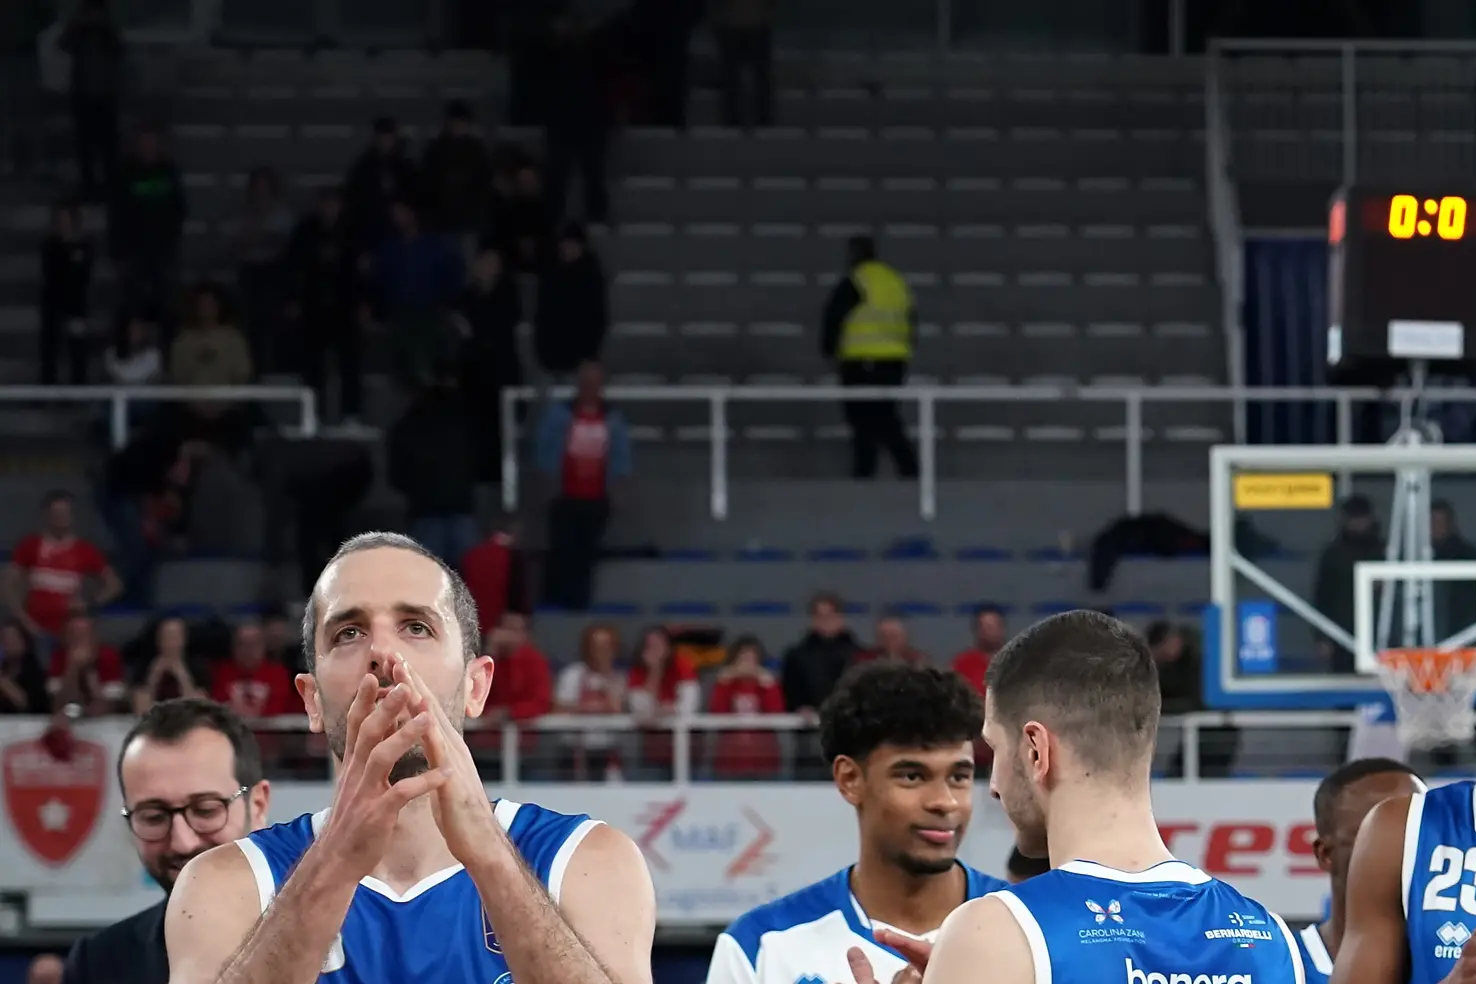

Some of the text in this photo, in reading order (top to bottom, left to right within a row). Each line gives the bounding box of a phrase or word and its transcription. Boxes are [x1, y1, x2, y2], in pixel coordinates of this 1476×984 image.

[1388, 194, 1467, 240] 0:0
[1078, 928, 1125, 939] CAROLINA
[1204, 928, 1272, 941] BERNARDELLI
[1434, 945, 1462, 959] erre
